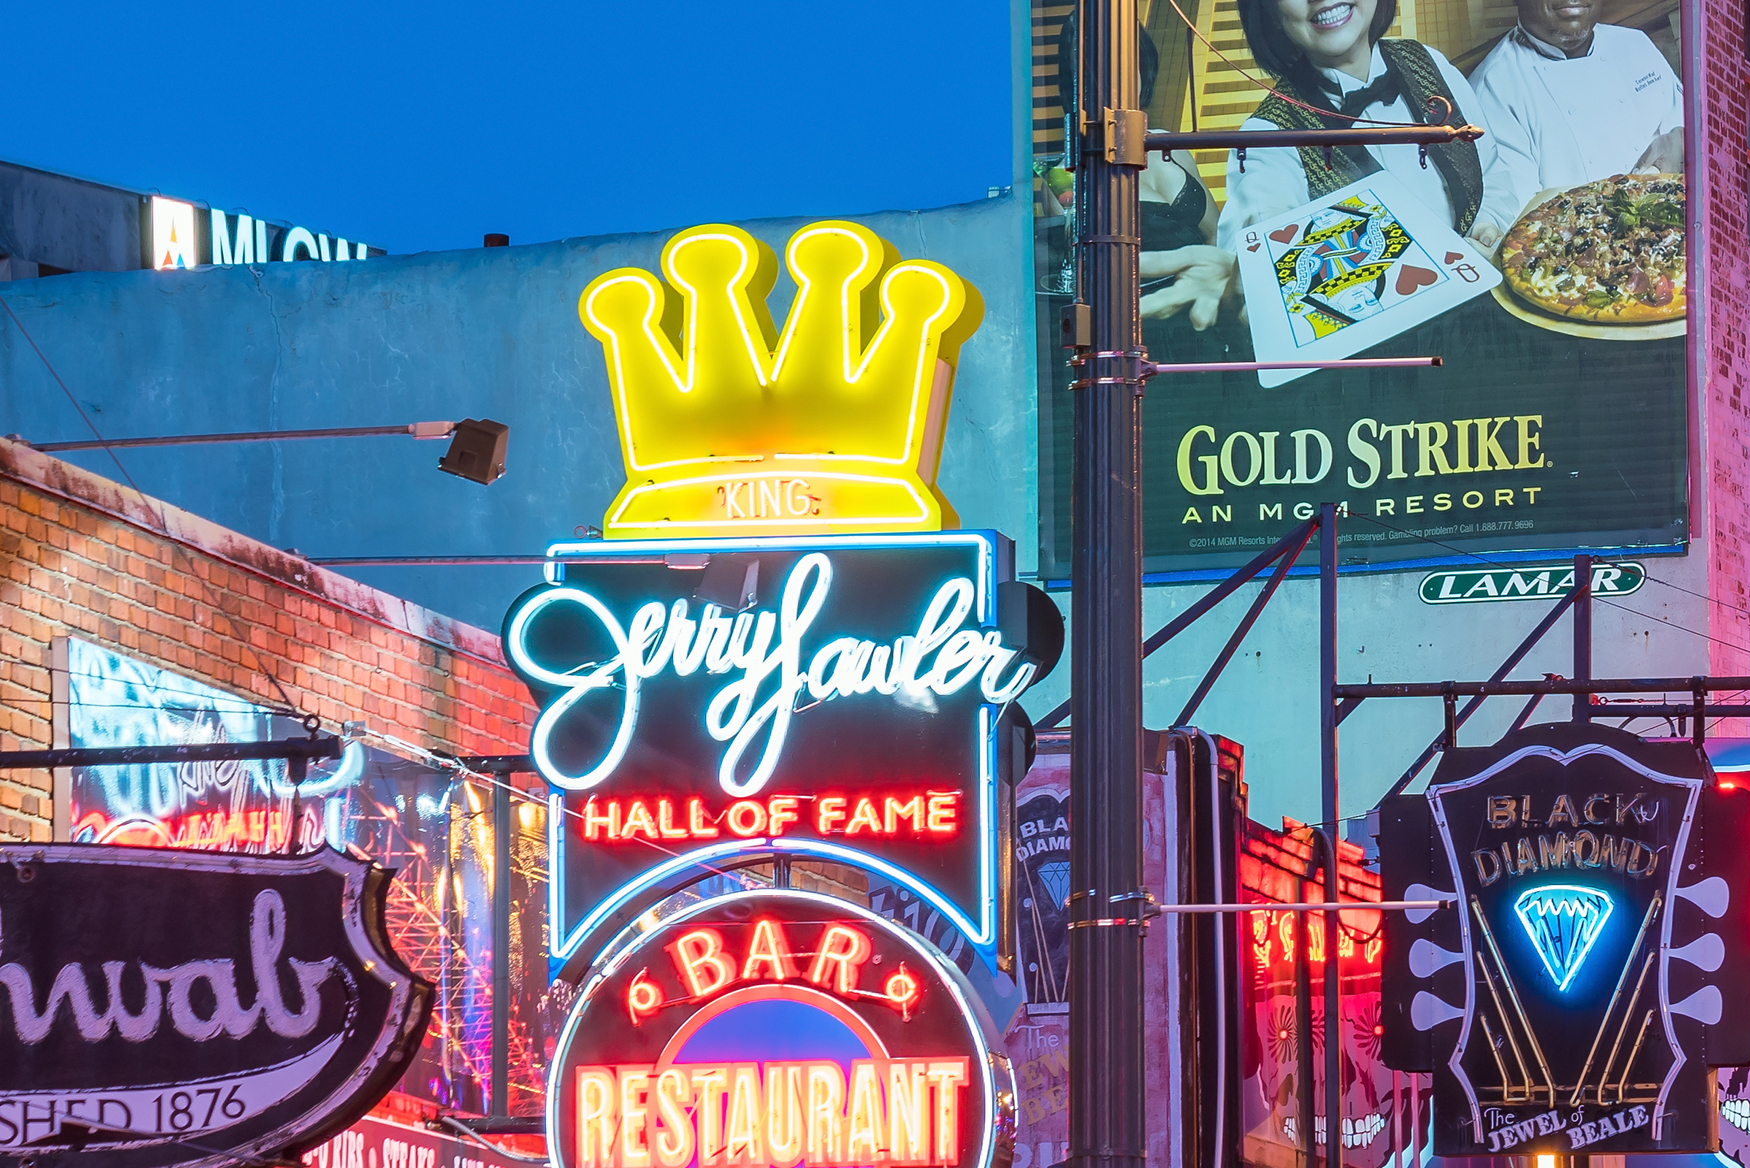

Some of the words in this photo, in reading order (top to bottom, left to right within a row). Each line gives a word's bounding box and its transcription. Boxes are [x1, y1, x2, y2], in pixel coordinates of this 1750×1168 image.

[1244, 231, 1260, 245] Q
[1451, 263, 1481, 284] Q
[1176, 424, 1332, 495] GOLD
[1347, 414, 1545, 488] STRIKE
[725, 480, 811, 518] KING
[1182, 505, 1232, 524] AN
[1376, 487, 1542, 516] RESORT
[1218, 537, 1237, 546] MGM
[1238, 536, 1266, 545] Resorts
[1353, 531, 1387, 542] reserved.
[1388, 528, 1422, 541] Gambling
[1423, 525, 1458, 538] problem?
[1459, 523, 1474, 534] Call
[1440, 568, 1622, 598] LAMAR
[509, 586, 777, 791] Jerry
[719, 552, 1037, 798] Lawler
[583, 795, 718, 841] HALL
[728, 796, 799, 837] OF
[817, 794, 961, 834] FAME
[1020, 819, 1069, 840] BLA
[1486, 793, 1658, 829] BLACK
[1472, 830, 1661, 887] DIAMOND
[671, 920, 871, 996] BAR
[1014, 1025, 1059, 1050] The
[152, 1084, 246, 1133] 1876
[1485, 1108, 1515, 1126] The
[1567, 1104, 1650, 1150] BEALE
[1571, 1105, 1585, 1126] of
[1487, 1108, 1567, 1153] JEWEL
